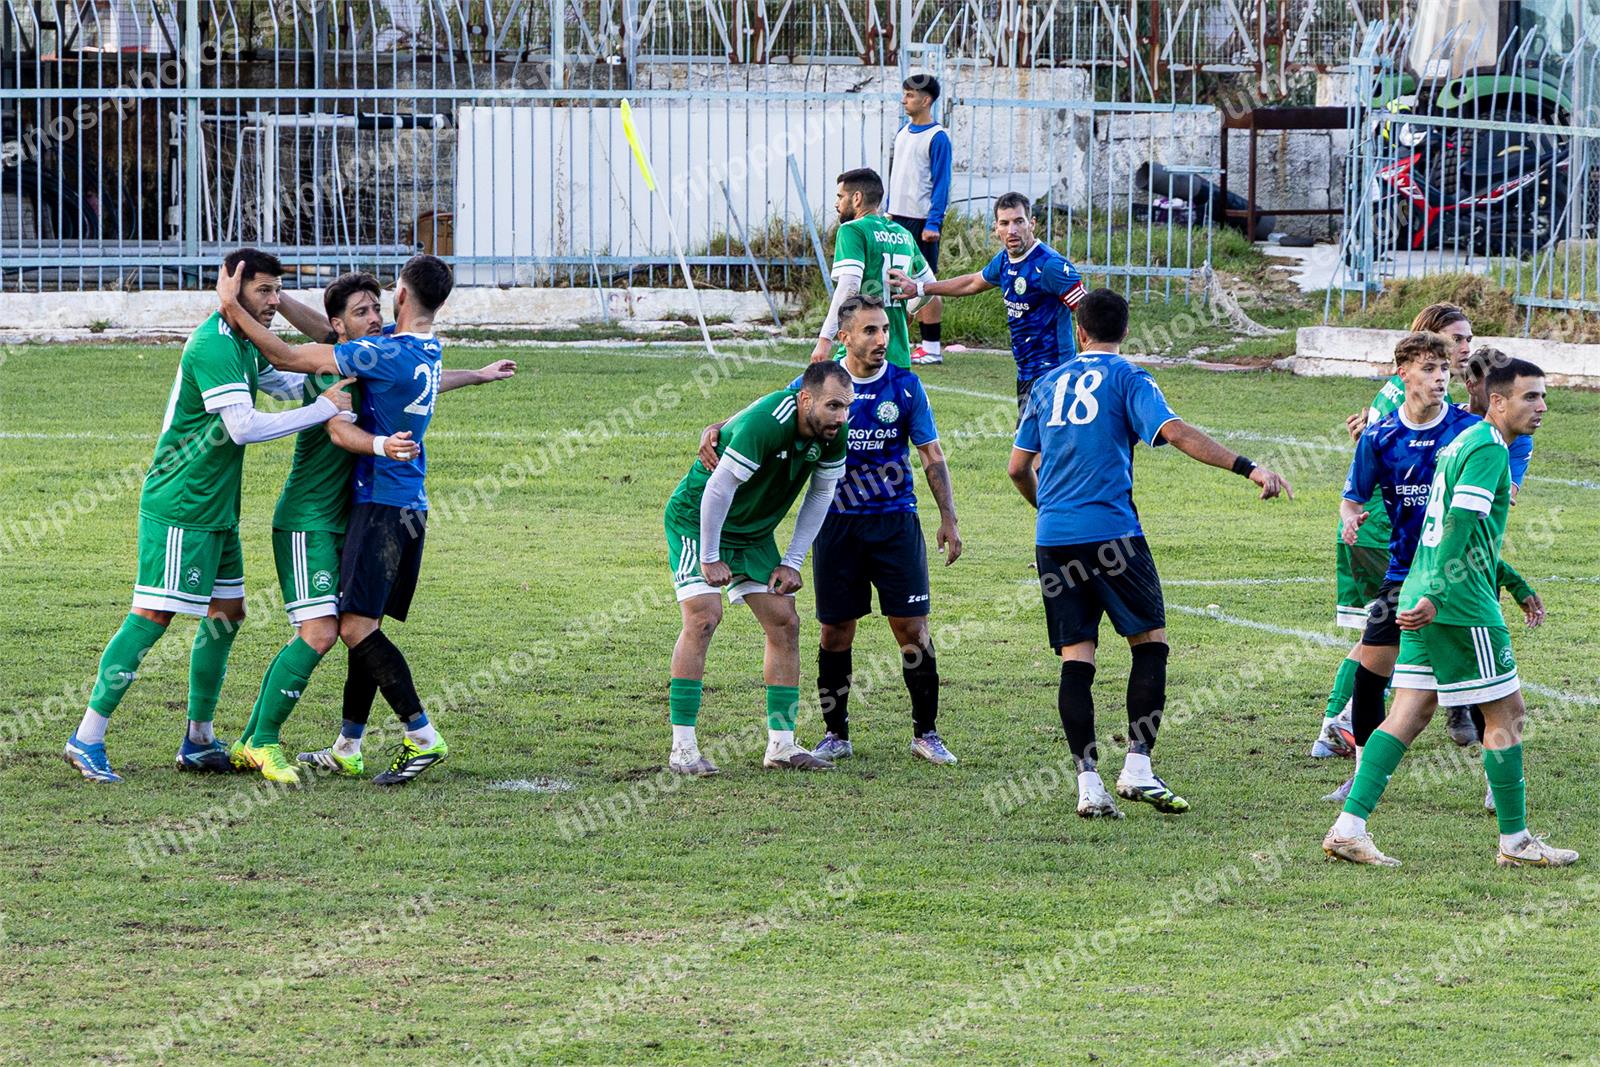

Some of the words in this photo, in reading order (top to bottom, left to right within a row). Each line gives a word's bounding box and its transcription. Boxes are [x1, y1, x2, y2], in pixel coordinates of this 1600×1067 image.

[1046, 370, 1103, 427] 18
[848, 429, 873, 440] RGY
[875, 428, 898, 439] GAS
[847, 441, 885, 451] YSTEM
[1408, 439, 1435, 448] Zeus
